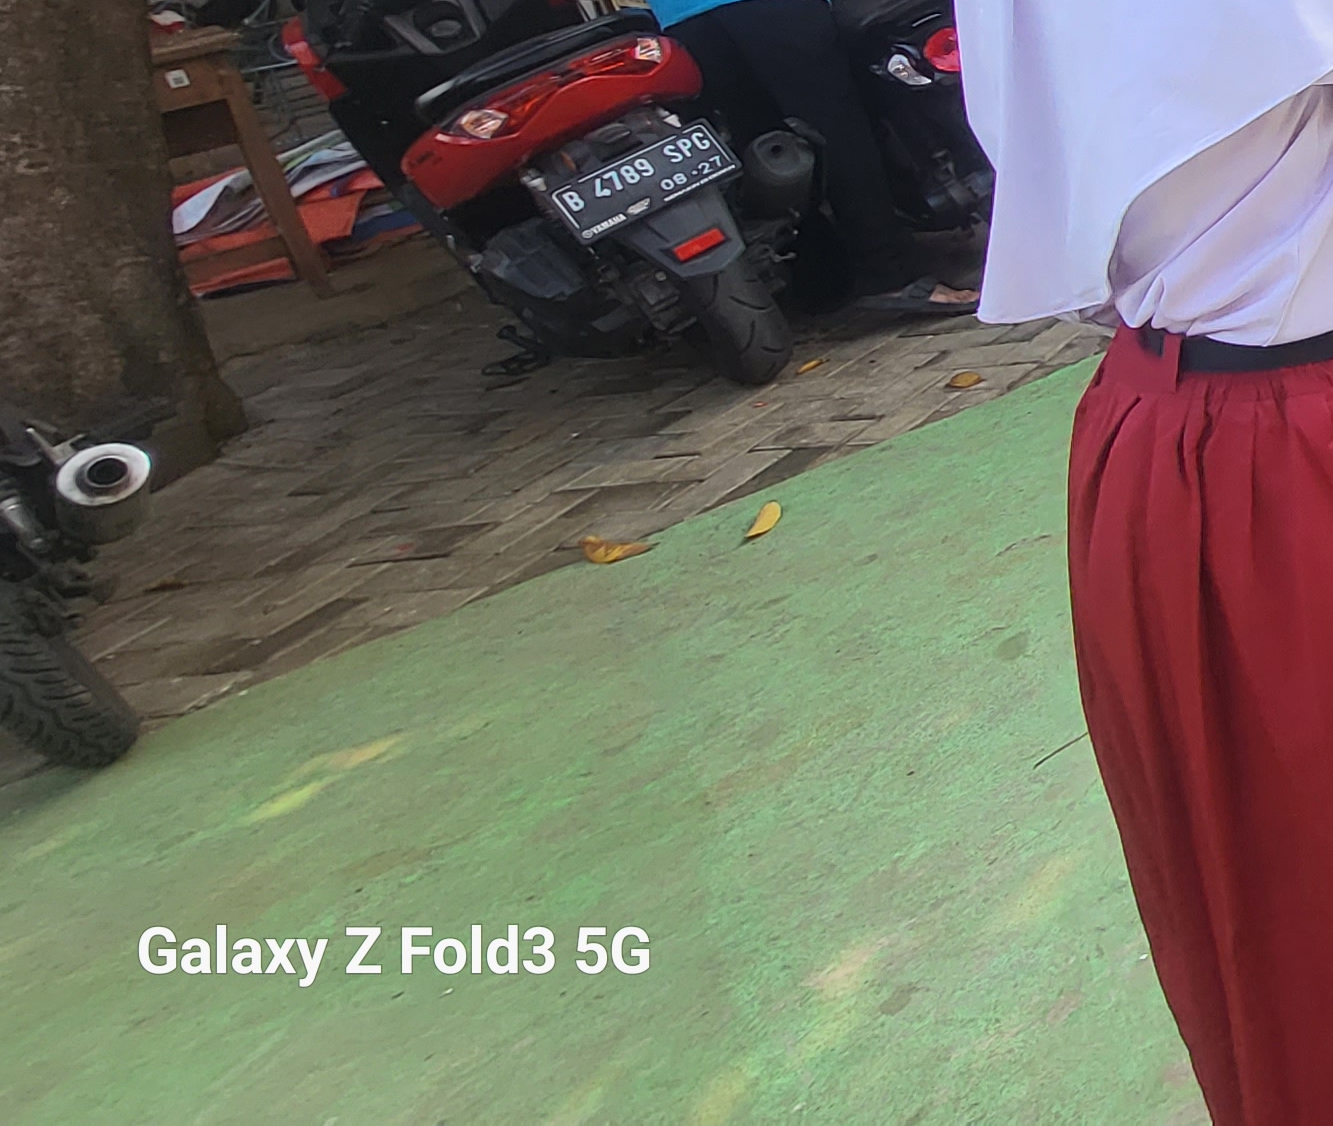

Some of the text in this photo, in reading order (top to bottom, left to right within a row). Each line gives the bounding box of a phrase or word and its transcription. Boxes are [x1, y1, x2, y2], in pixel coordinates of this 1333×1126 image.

[561, 190, 586, 213] B
[593, 157, 655, 199] 4789
[591, 213, 628, 236] YAMAHA
